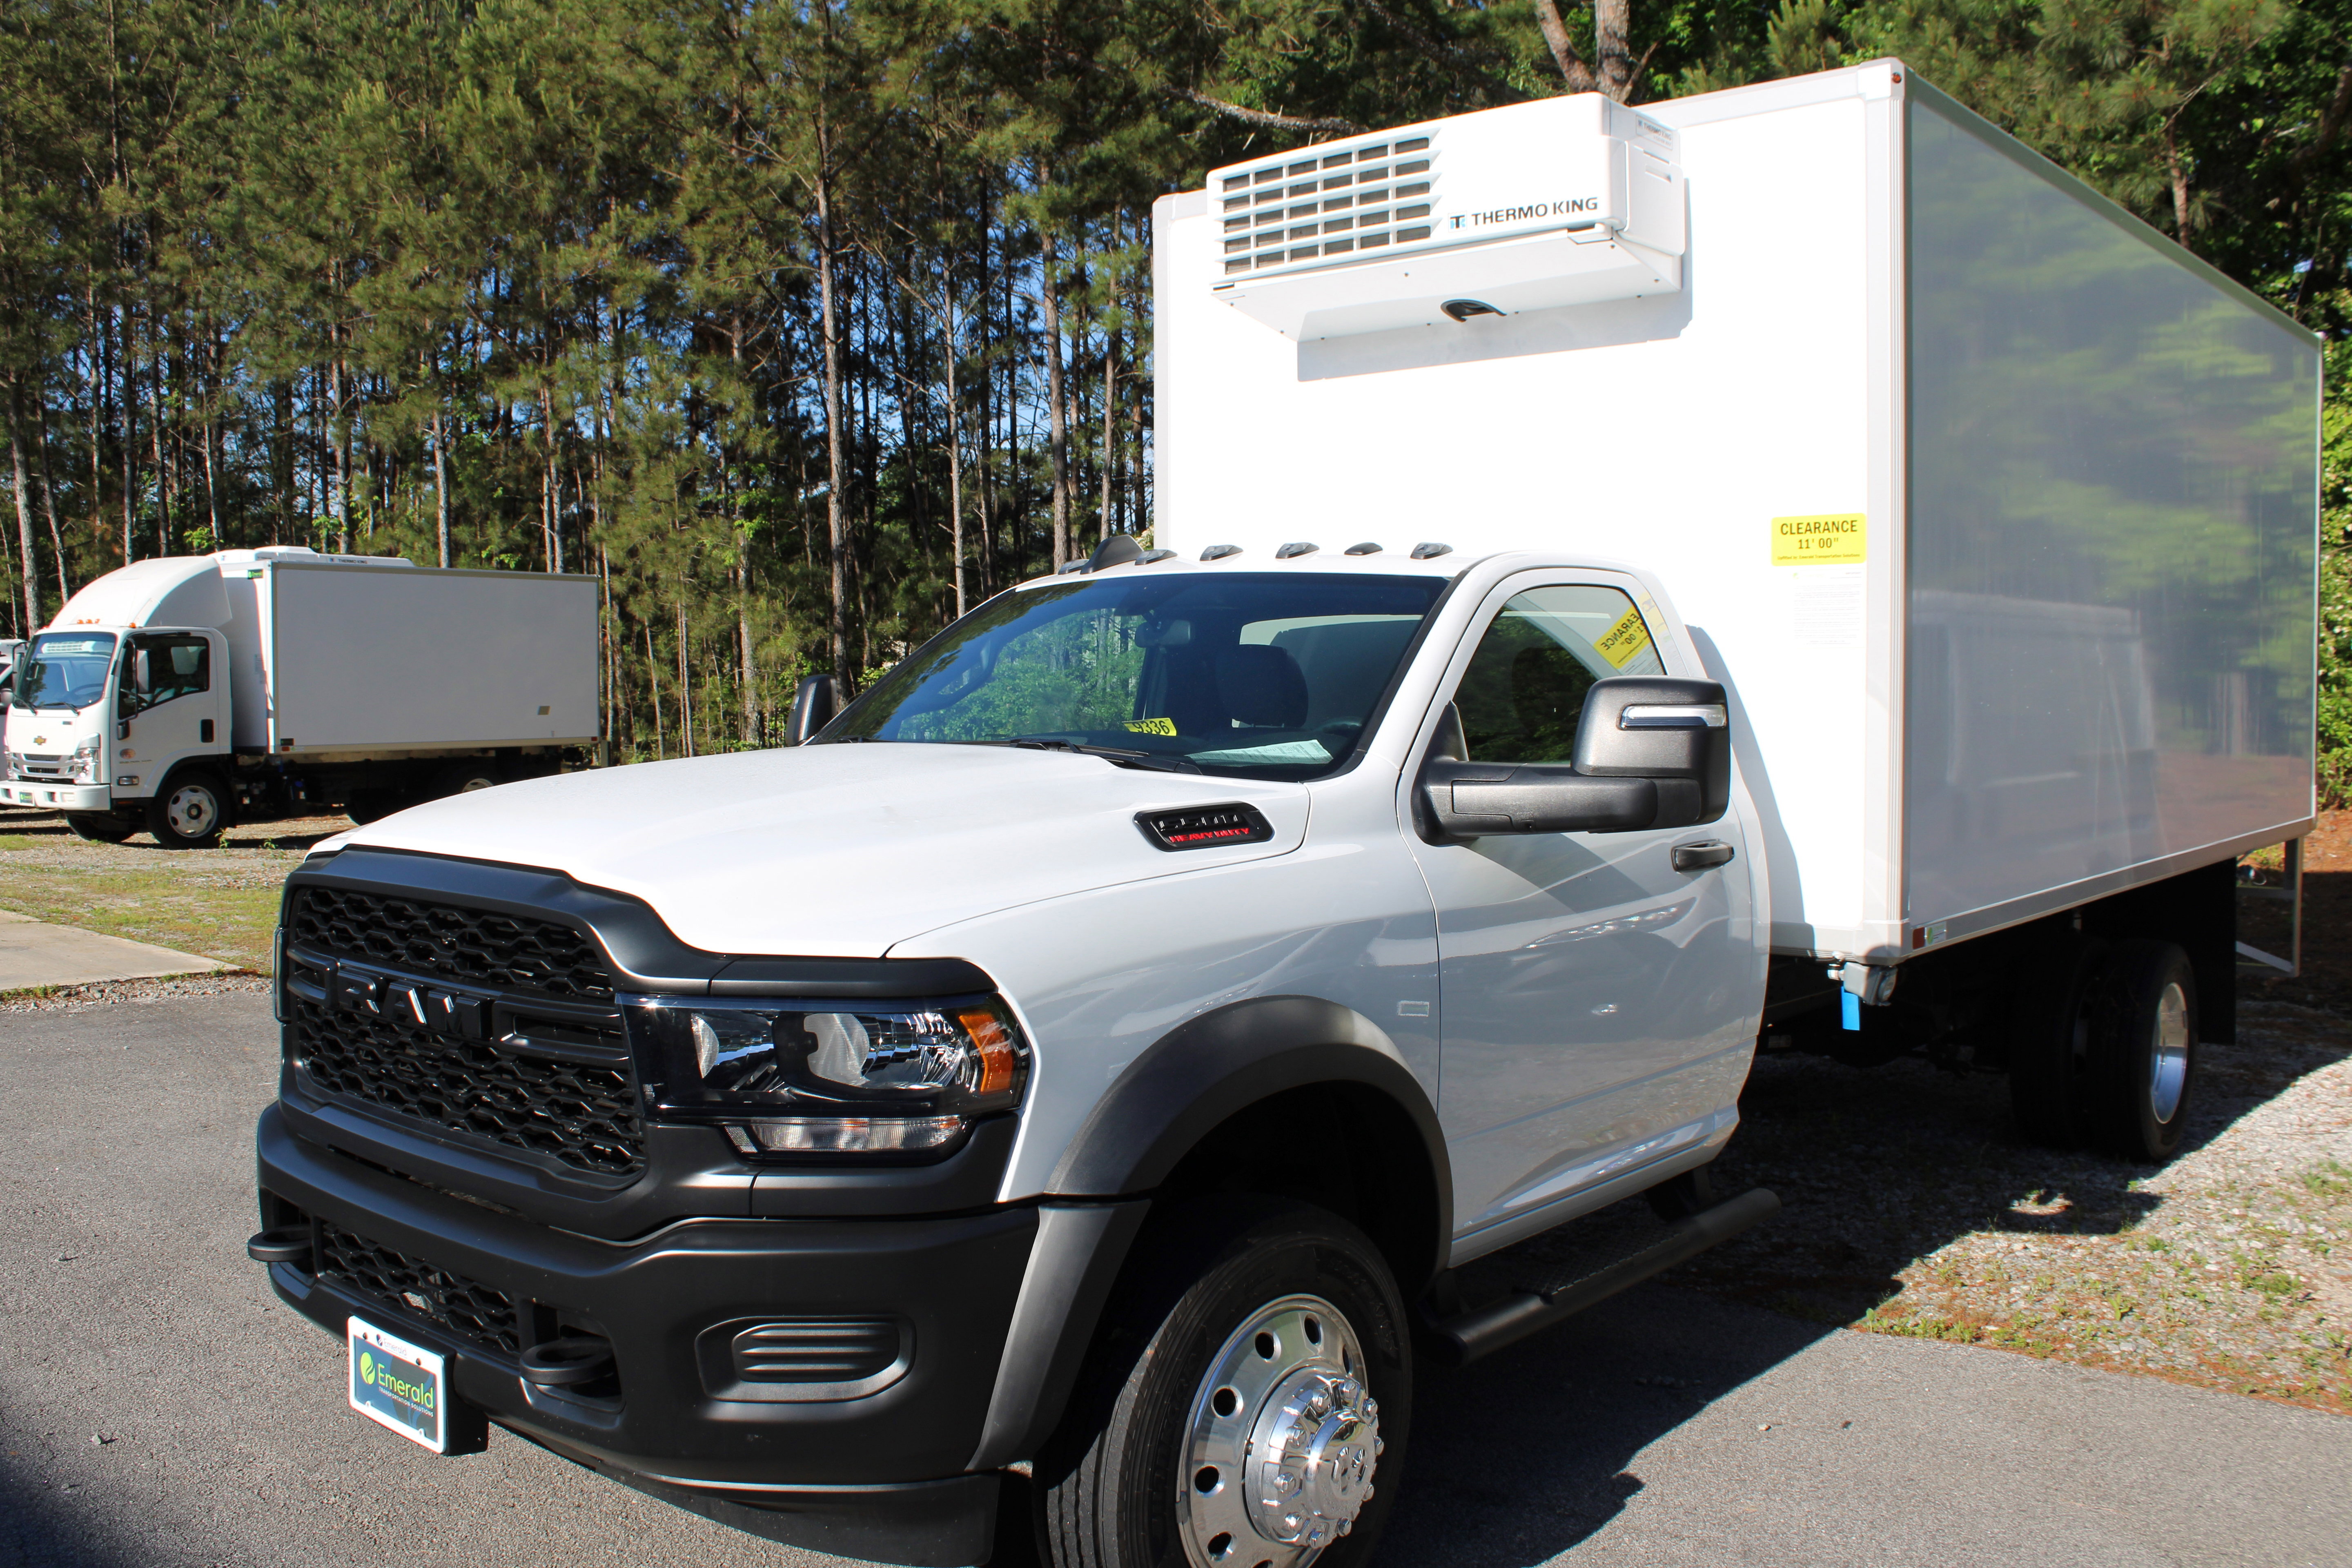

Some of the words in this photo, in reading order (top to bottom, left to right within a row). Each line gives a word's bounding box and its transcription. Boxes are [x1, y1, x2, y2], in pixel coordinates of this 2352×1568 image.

[1472, 203, 1548, 225] THERMO
[1552, 197, 1598, 214] KING
[1780, 520, 1858, 535] CLEARANCE
[1798, 539, 1815, 549] 11'
[1818, 537, 1839, 548] 00"
[1132, 720, 1170, 735] 9336
[1169, 831, 1214, 843] HEAVY
[1214, 827, 1250, 837] DUTY
[337, 969, 480, 1038] RAM
[383, 1339, 407, 1356] Emerald
[378, 1363, 434, 1409] Emerald
[379, 1386, 411, 1407] TRANSPORTATION
[411, 1403, 434, 1418] SOLUTIONS
